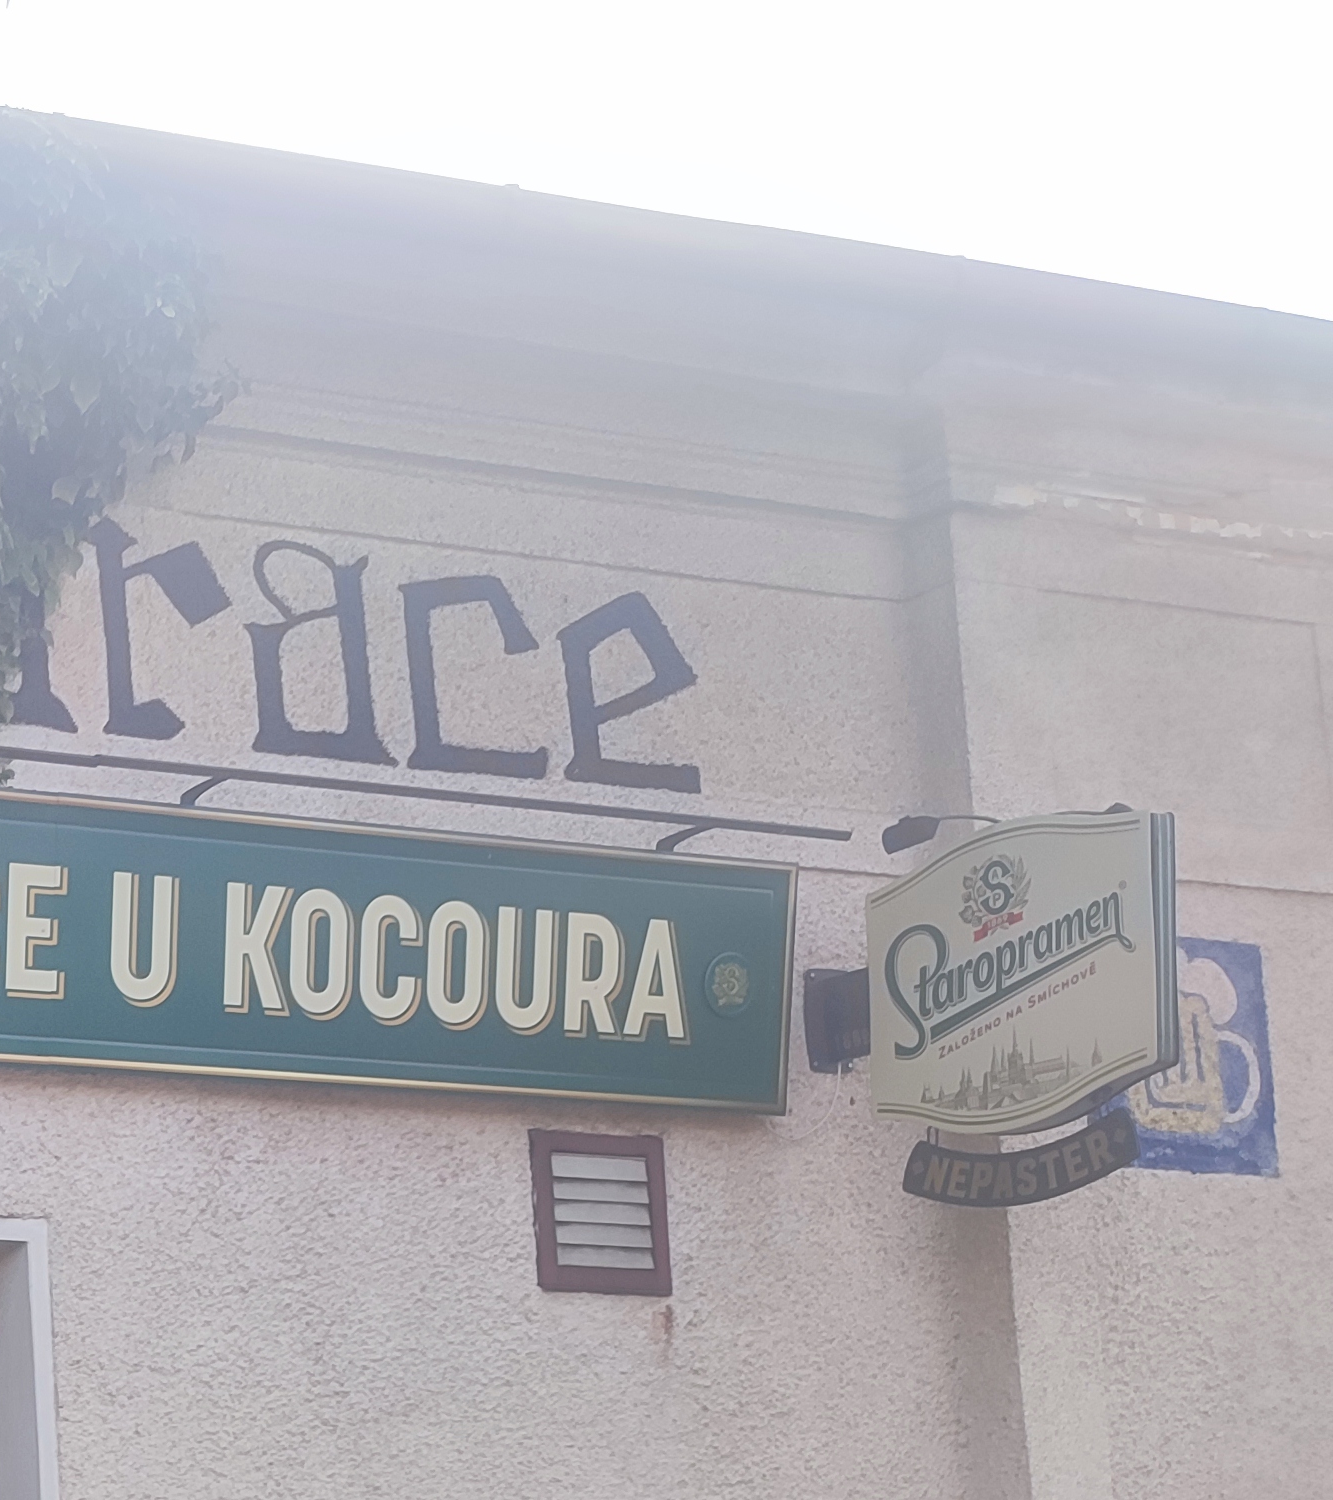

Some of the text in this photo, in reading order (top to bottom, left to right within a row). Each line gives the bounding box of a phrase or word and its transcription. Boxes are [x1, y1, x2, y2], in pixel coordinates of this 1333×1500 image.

[110, 870, 180, 1008] U
[223, 881, 691, 1046] KOCOURA
[884, 891, 1136, 1060] Staropramen
[1005, 1005, 1024, 1021] NA
[923, 1129, 1116, 1199] NEPASTER
